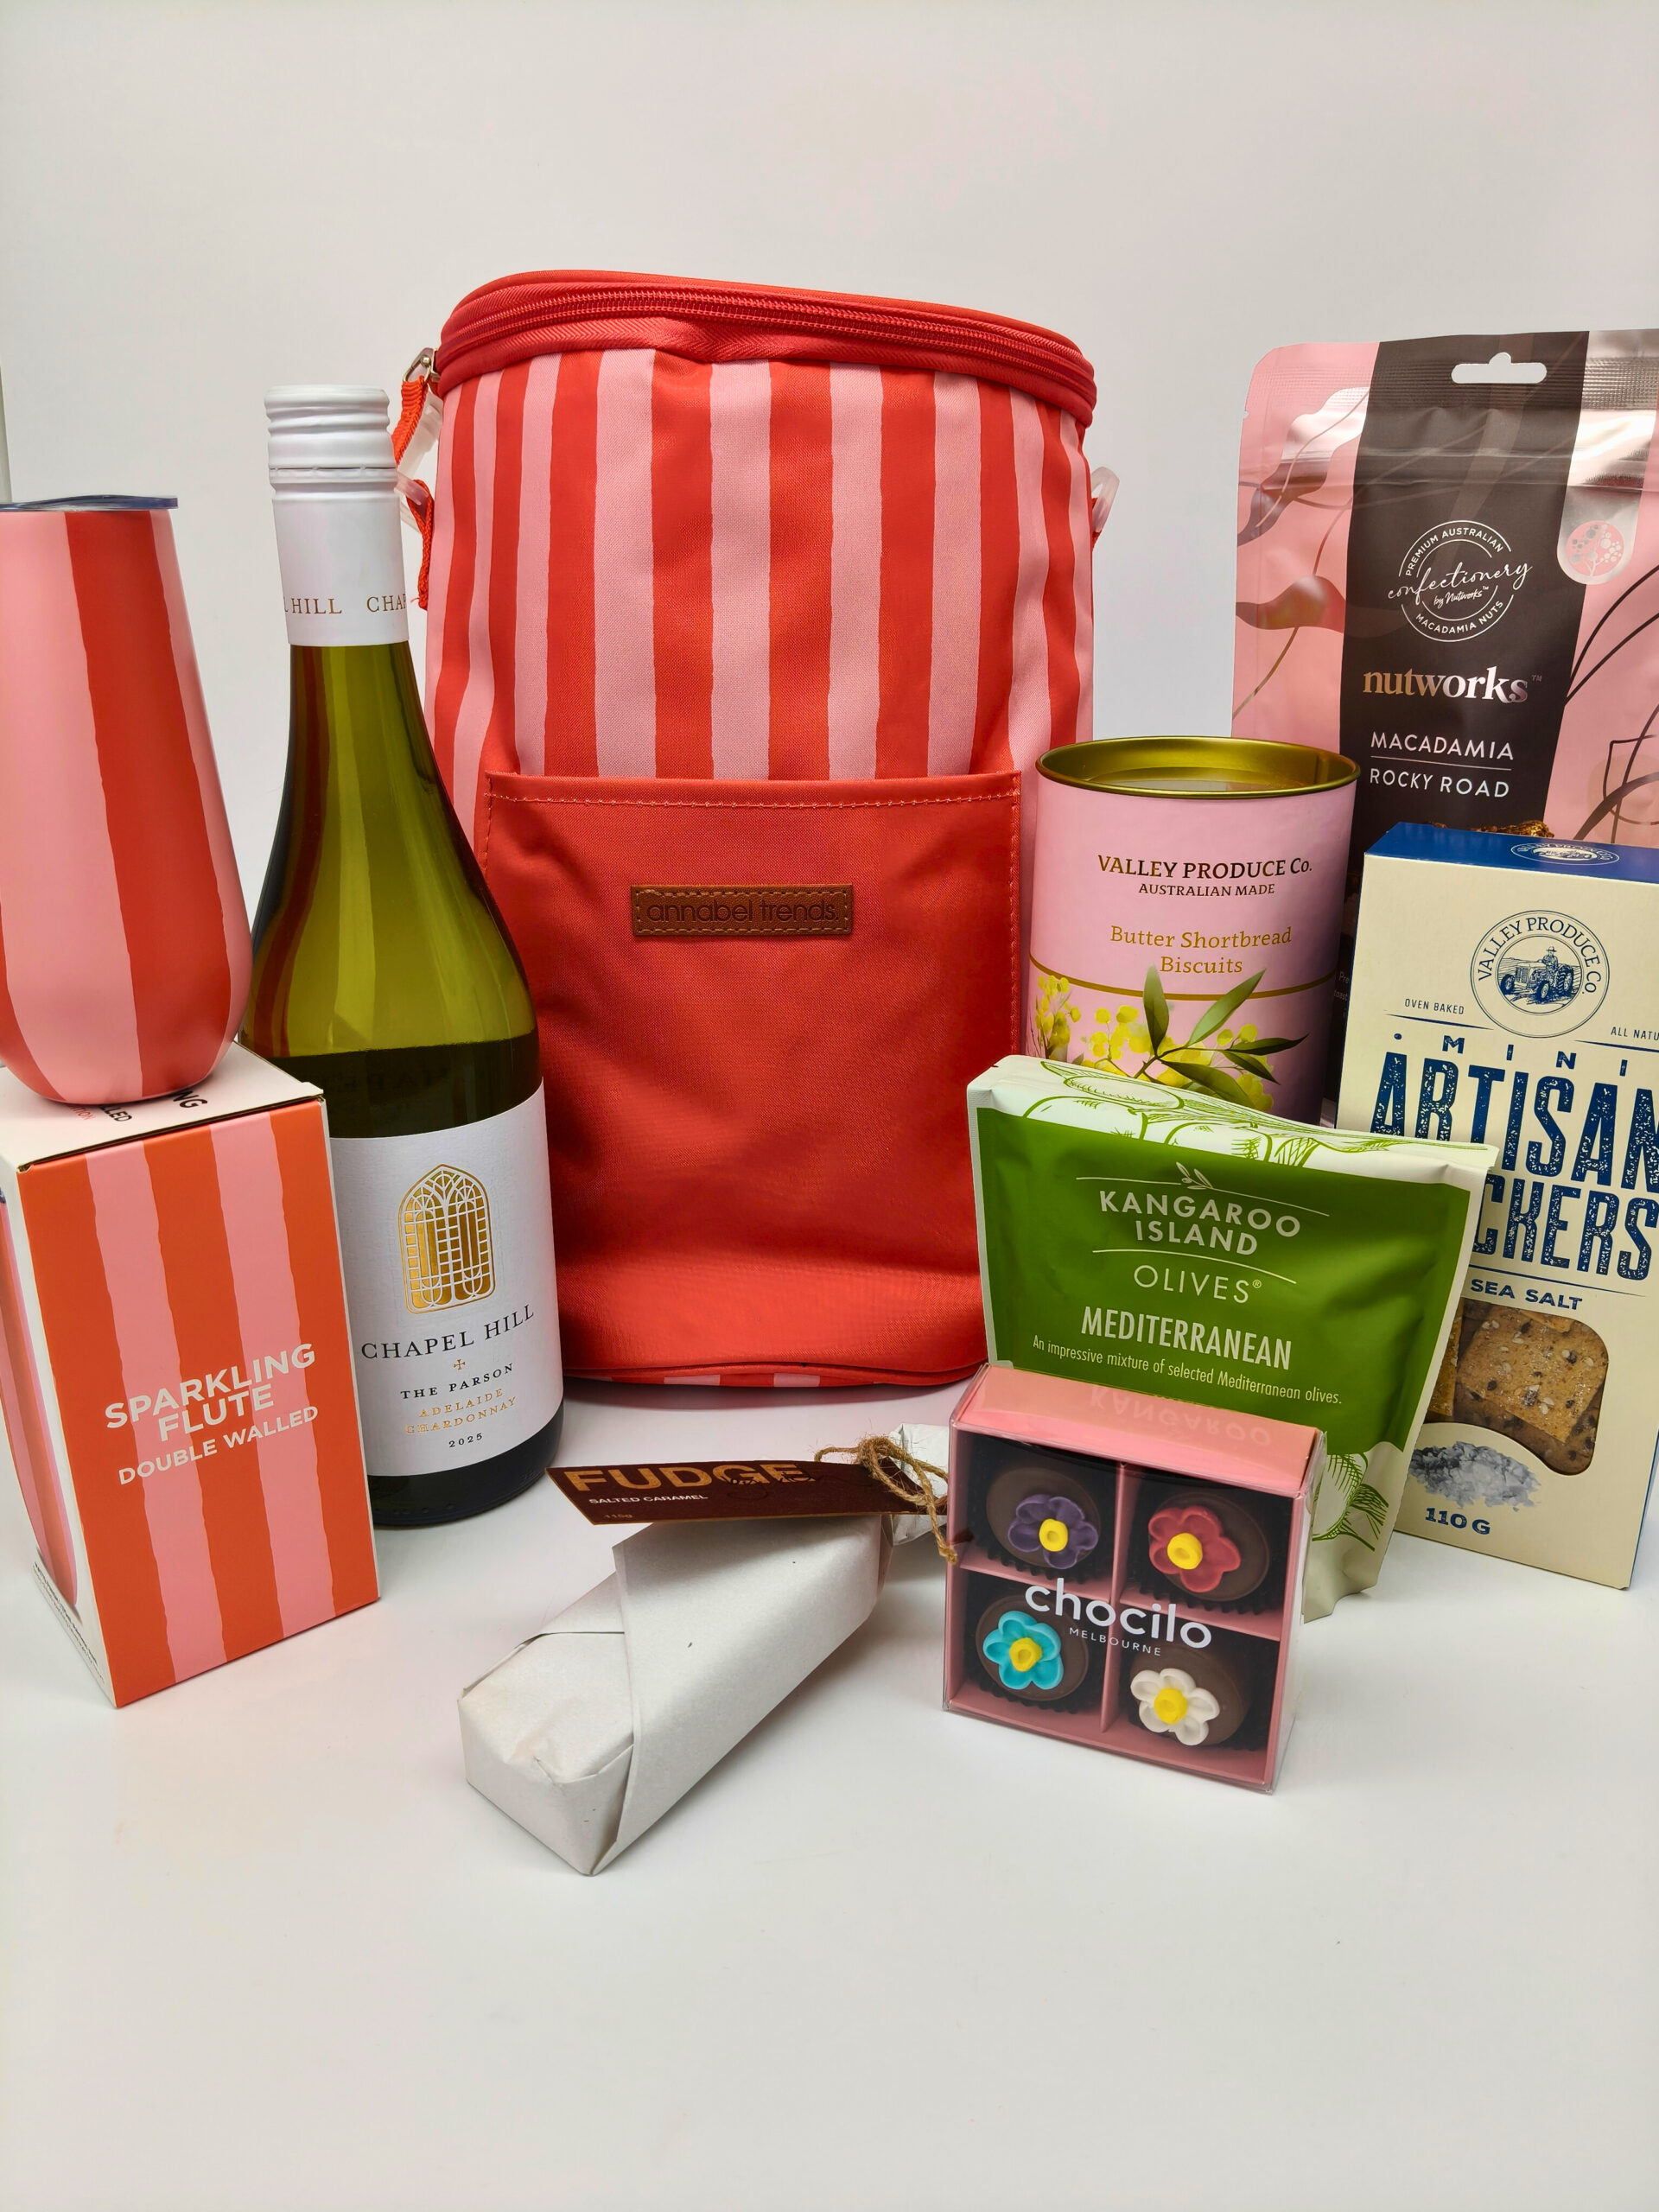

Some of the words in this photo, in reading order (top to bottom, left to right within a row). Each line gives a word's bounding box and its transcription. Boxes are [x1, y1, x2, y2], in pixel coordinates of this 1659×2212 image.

[1405, 534, 1439, 576] PREMIUM
[1441, 527, 1503, 553] AUSTRALIAN
[1388, 562, 1533, 605] confectionery
[291, 597, 342, 614] HILL
[1415, 613, 1477, 634] MACADAMIA
[1478, 600, 1503, 625] NUTS
[1433, 595, 1444, 608] by
[1370, 731, 1514, 760] MACADAMIA
[1370, 768, 1433, 791] ROCKY
[1440, 777, 1510, 798] ROAD
[1097, 854, 1177, 879] VALLEY
[1183, 859, 1286, 880] PRODUCE
[1290, 857, 1313, 874] Co.
[1138, 882, 1231, 897] AUSTRALIAN
[1235, 883, 1275, 896] MADE
[649, 899, 753, 922] annabel
[1109, 925, 1175, 948] Butter
[1180, 926, 1293, 949] Shortbread
[1478, 919, 1524, 982] VALLEY
[1526, 916, 1601, 969] PRODUCE
[1160, 956, 1243, 974] Biscuits
[1404, 998, 1430, 1011] OVEN
[1433, 1001, 1465, 1016] BAKED
[1611, 1027, 1628, 1037] ALL
[1633, 1029, 1659, 1041] NATU
[1370, 1051, 1659, 1193] ARTISAN
[1099, 1190, 1301, 1238] KANGAROO
[1472, 1173, 1659, 1281] CKERS
[1135, 1220, 1258, 1255] ISLAND
[1471, 1278, 1516, 1300] SEA
[1525, 1287, 1583, 1311] SALT
[361, 1330, 474, 1360] CHAPEL
[485, 1304, 534, 1341] HILL
[1081, 1306, 1292, 1370] MEDITERRANEAN
[105, 1343, 316, 1429] SPARKLING
[400, 1387, 438, 1400] THE
[448, 1363, 513, 1393] PARSON
[1033, 1334, 1045, 1351] An
[1047, 1340, 1103, 1363] impressive
[1107, 1352, 1149, 1371] mixture
[1153, 1358, 1166, 1374] of
[1167, 1362, 1214, 1384] selected
[1217, 1370, 1300, 1400] Mediterranean
[1305, 1386, 1342, 1405] olives.
[157, 1383, 276, 1443] FLUTE
[404, 1395, 517, 1435] CHARDONNAY
[418, 1388, 503, 1418] ADELAIDE
[118, 1440, 218, 1486] DOUBLE
[224, 1405, 319, 1447] WALLED
[448, 1432, 484, 1449] 2025
[563, 1464, 817, 1491] FUDGE
[1025, 1578, 1211, 1649] chocilo
[1069, 1626, 1162, 1656] MELBOURNE
